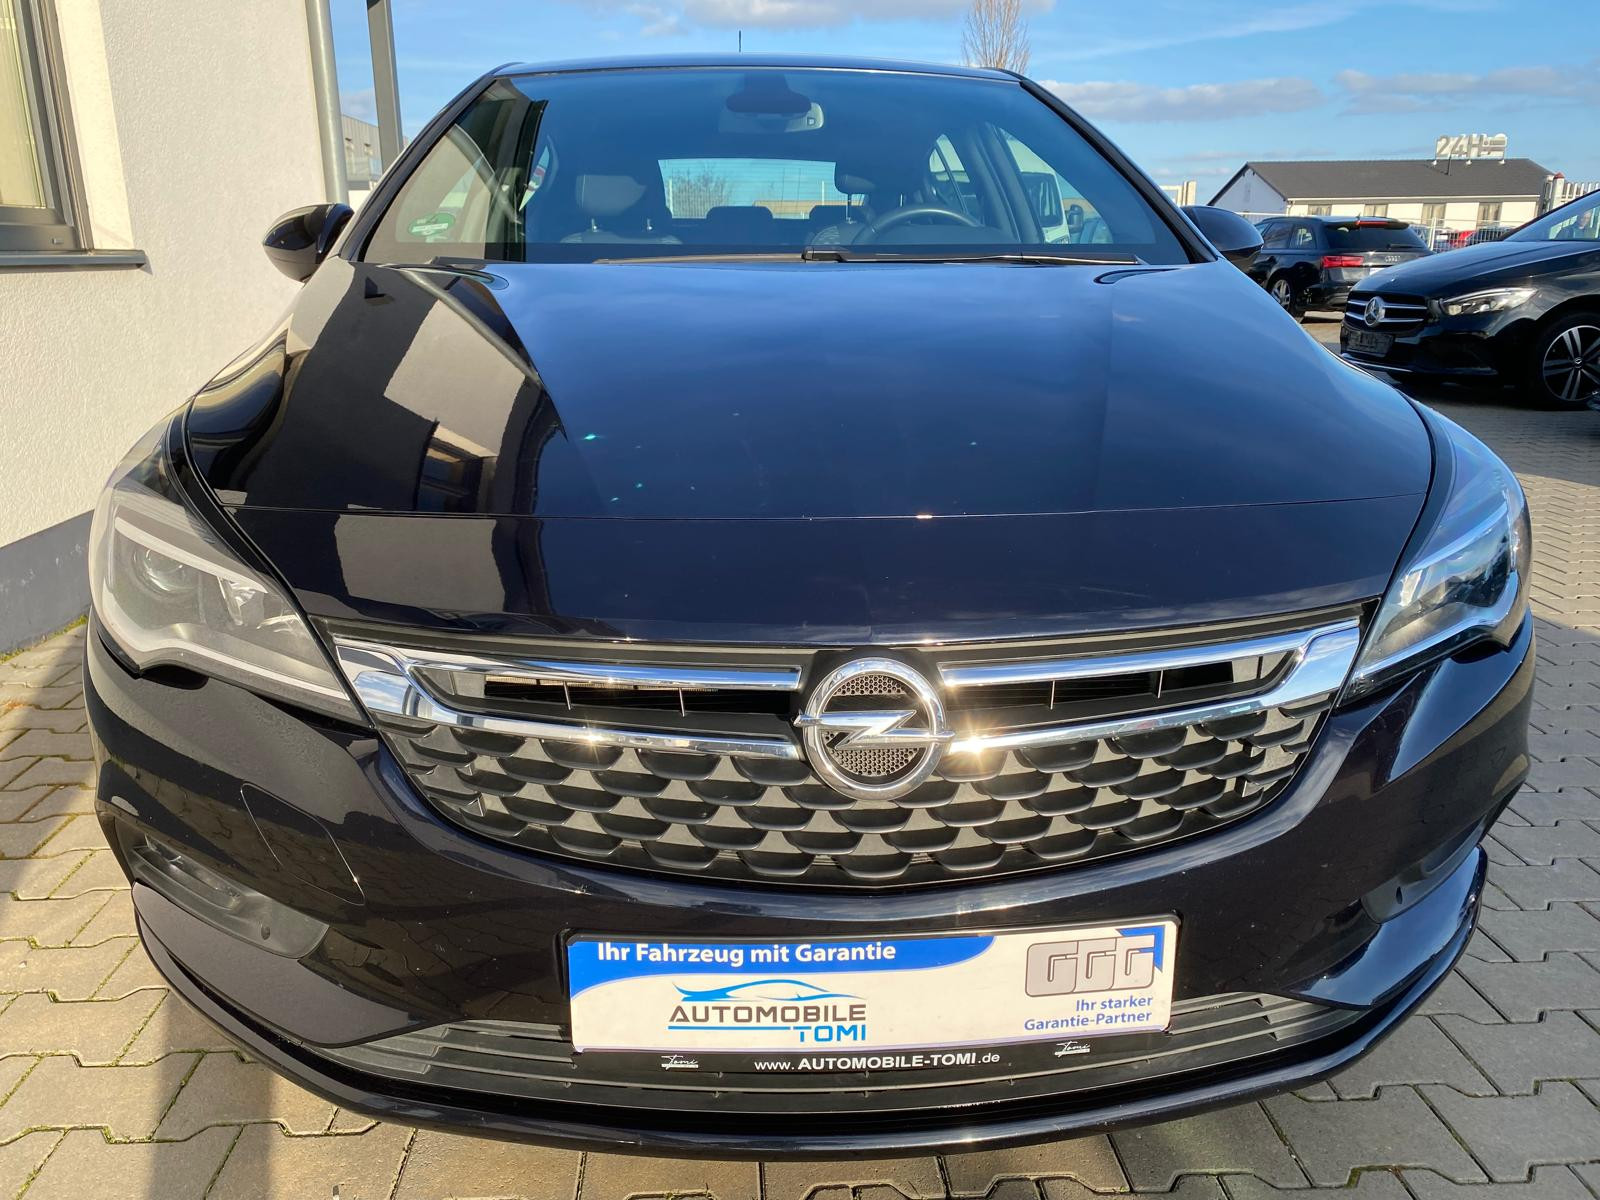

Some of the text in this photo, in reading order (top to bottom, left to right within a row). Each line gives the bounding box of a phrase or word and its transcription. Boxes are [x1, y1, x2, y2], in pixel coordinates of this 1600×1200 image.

[598, 942, 896, 967] Ihr Fahrzeug mit Garantie
[1076, 995, 1154, 1011] Ihr starker
[669, 1004, 867, 1023] AUTOMOBILE
[1024, 1011, 1152, 1031] Garantie-Partner
[793, 1024, 866, 1043] TOMI
